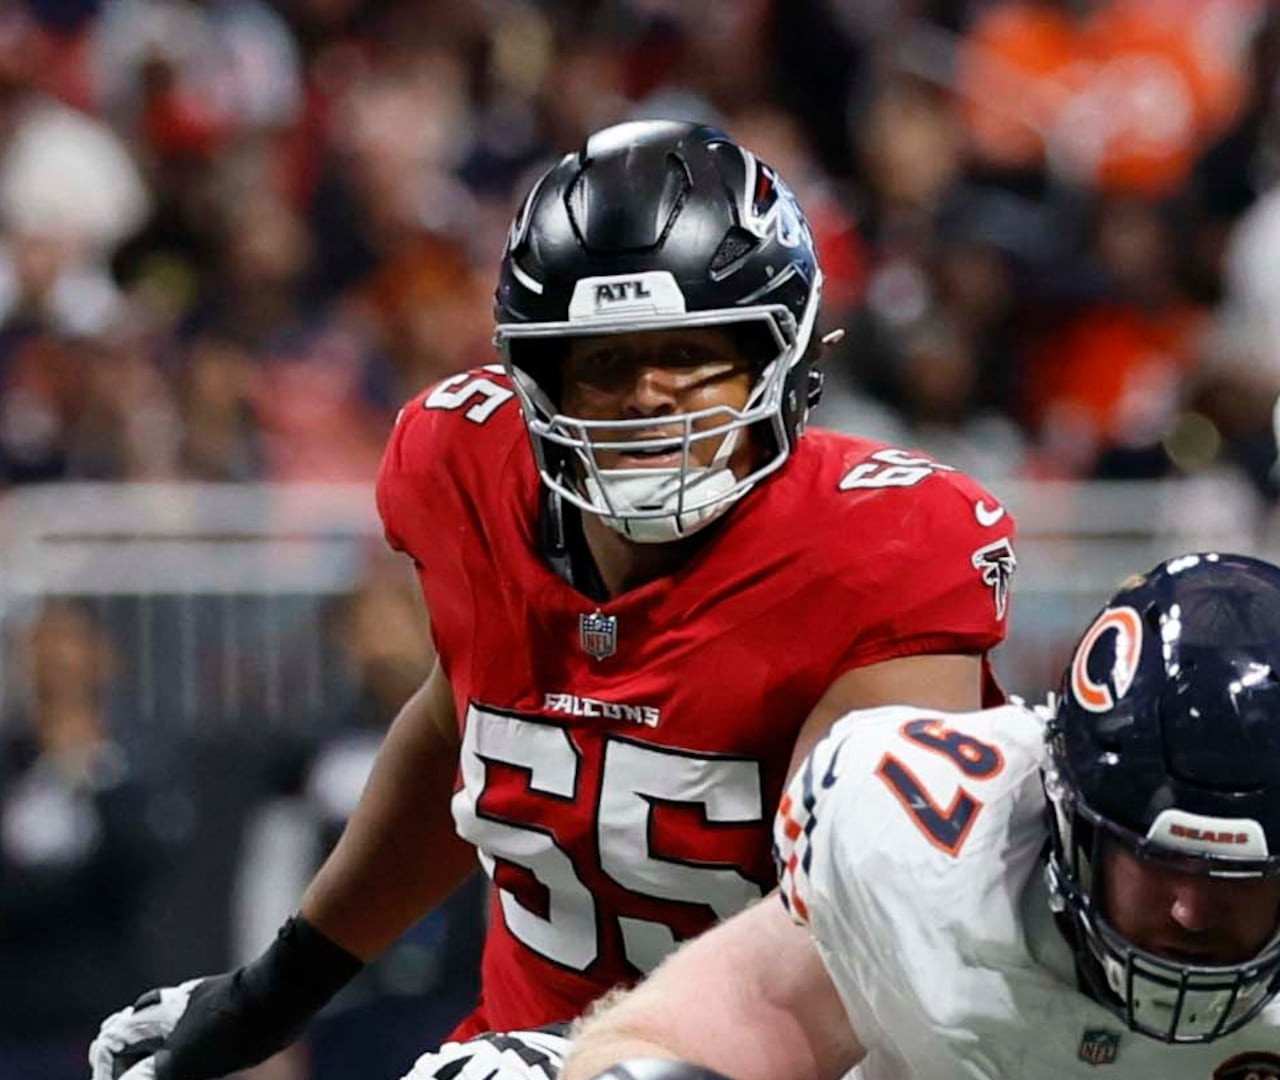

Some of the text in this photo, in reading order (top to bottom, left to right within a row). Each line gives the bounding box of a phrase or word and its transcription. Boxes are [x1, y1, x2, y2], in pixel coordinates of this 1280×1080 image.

[594, 281, 651, 308] ATL
[543, 692, 661, 729] FALCONS
[874, 718, 1006, 858] 97
[450, 701, 768, 977] 65
[1170, 824, 1250, 846] BEARS
